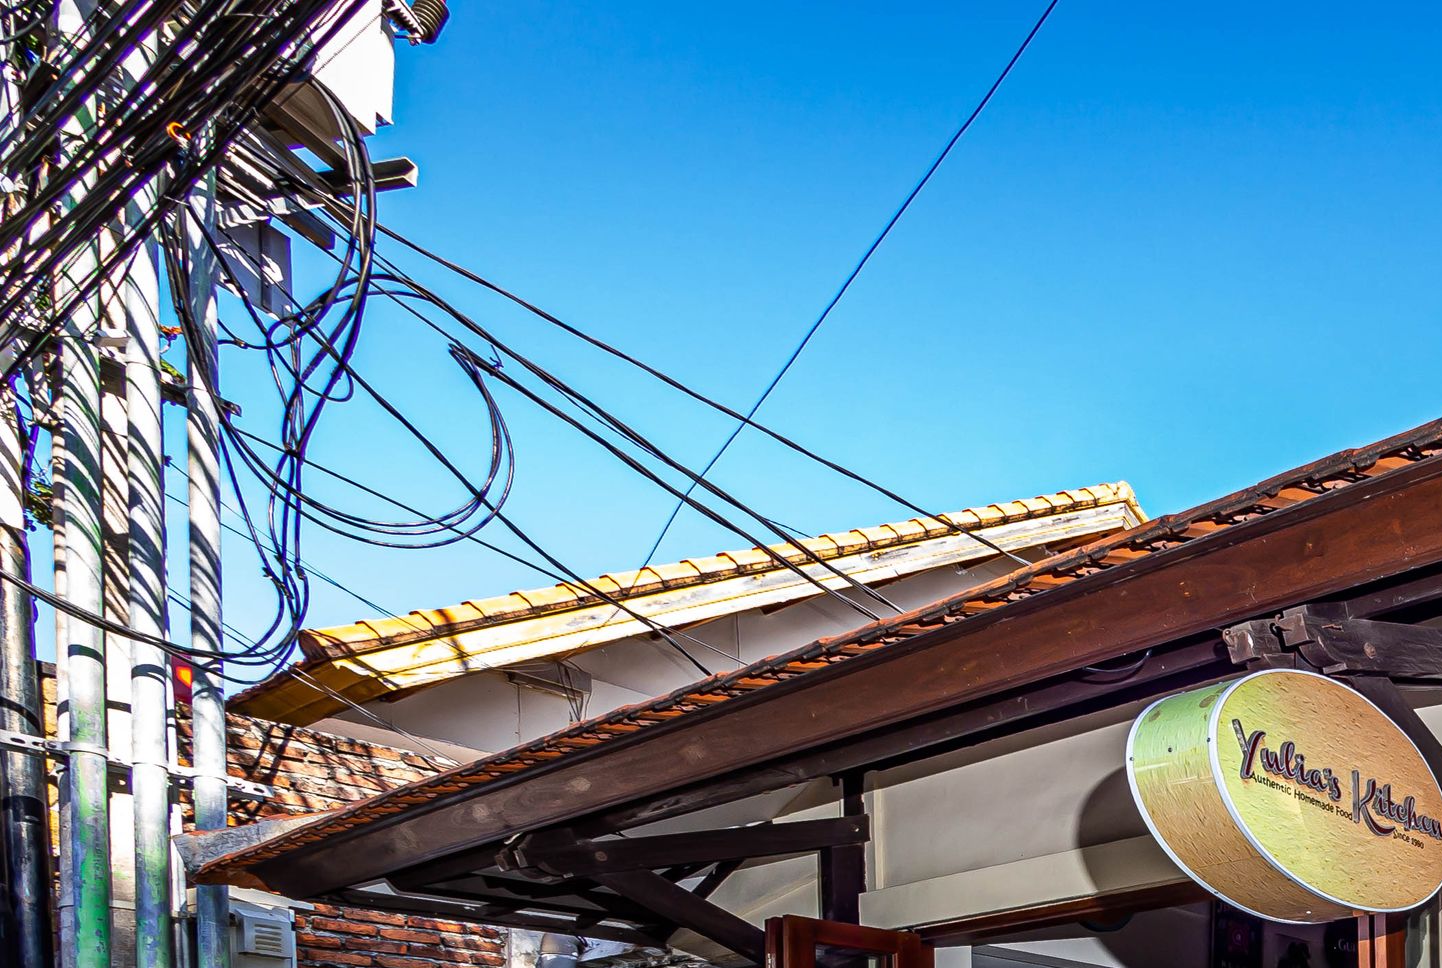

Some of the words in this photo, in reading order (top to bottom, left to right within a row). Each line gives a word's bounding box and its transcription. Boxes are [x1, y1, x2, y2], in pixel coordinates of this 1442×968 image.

[1231, 718, 1342, 801] Yulia's
[1250, 771, 1292, 795] Authentic
[1294, 788, 1335, 814] Homemade
[1335, 806, 1353, 821] Food
[1393, 829, 1410, 843] Since
